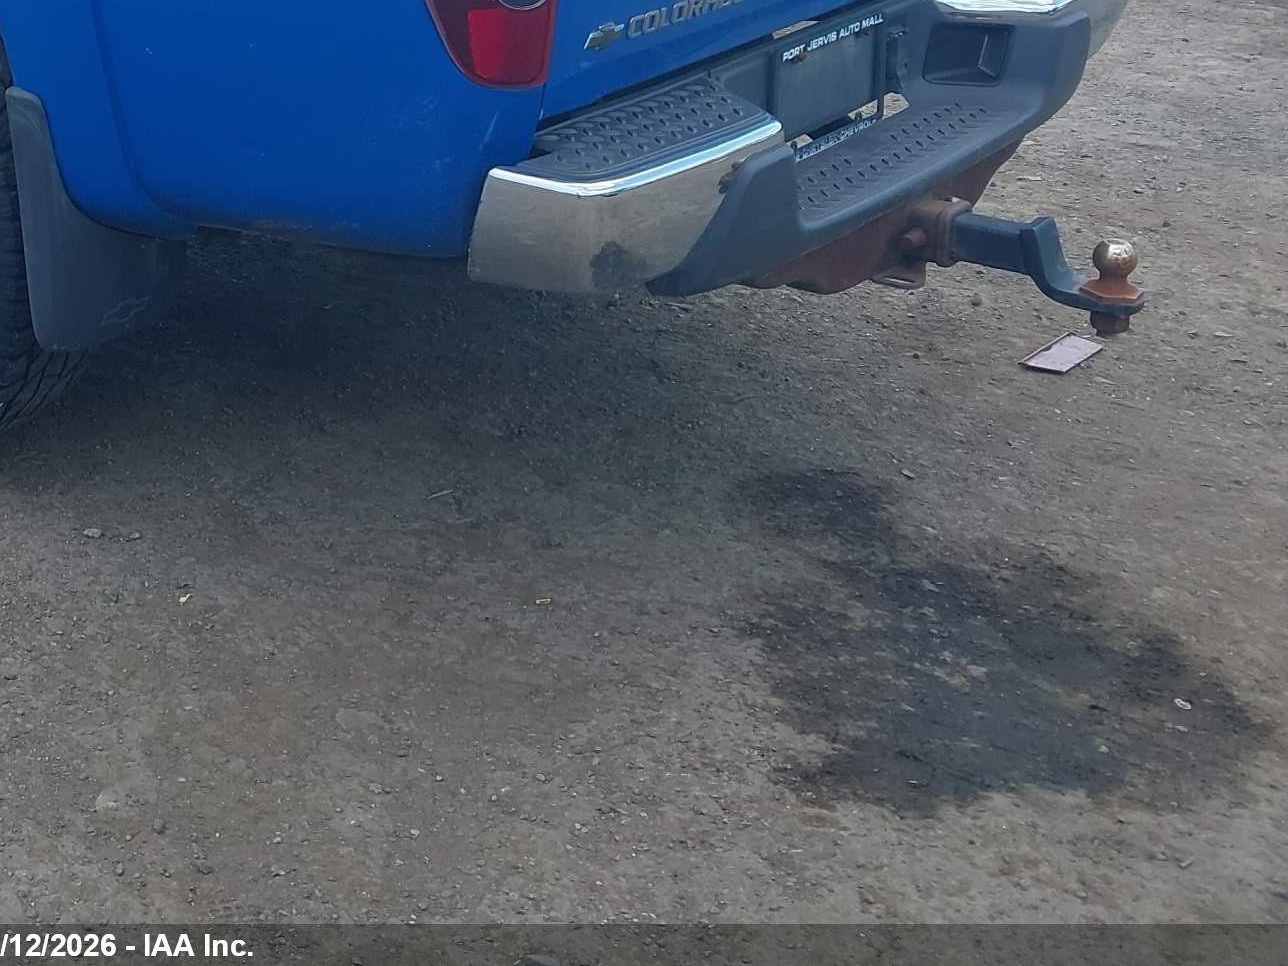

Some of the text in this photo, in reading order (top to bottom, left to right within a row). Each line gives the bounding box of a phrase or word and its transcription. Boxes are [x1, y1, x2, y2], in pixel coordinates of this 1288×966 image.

[782, 13, 885, 63] PORT JERVIS AUTO MALL
